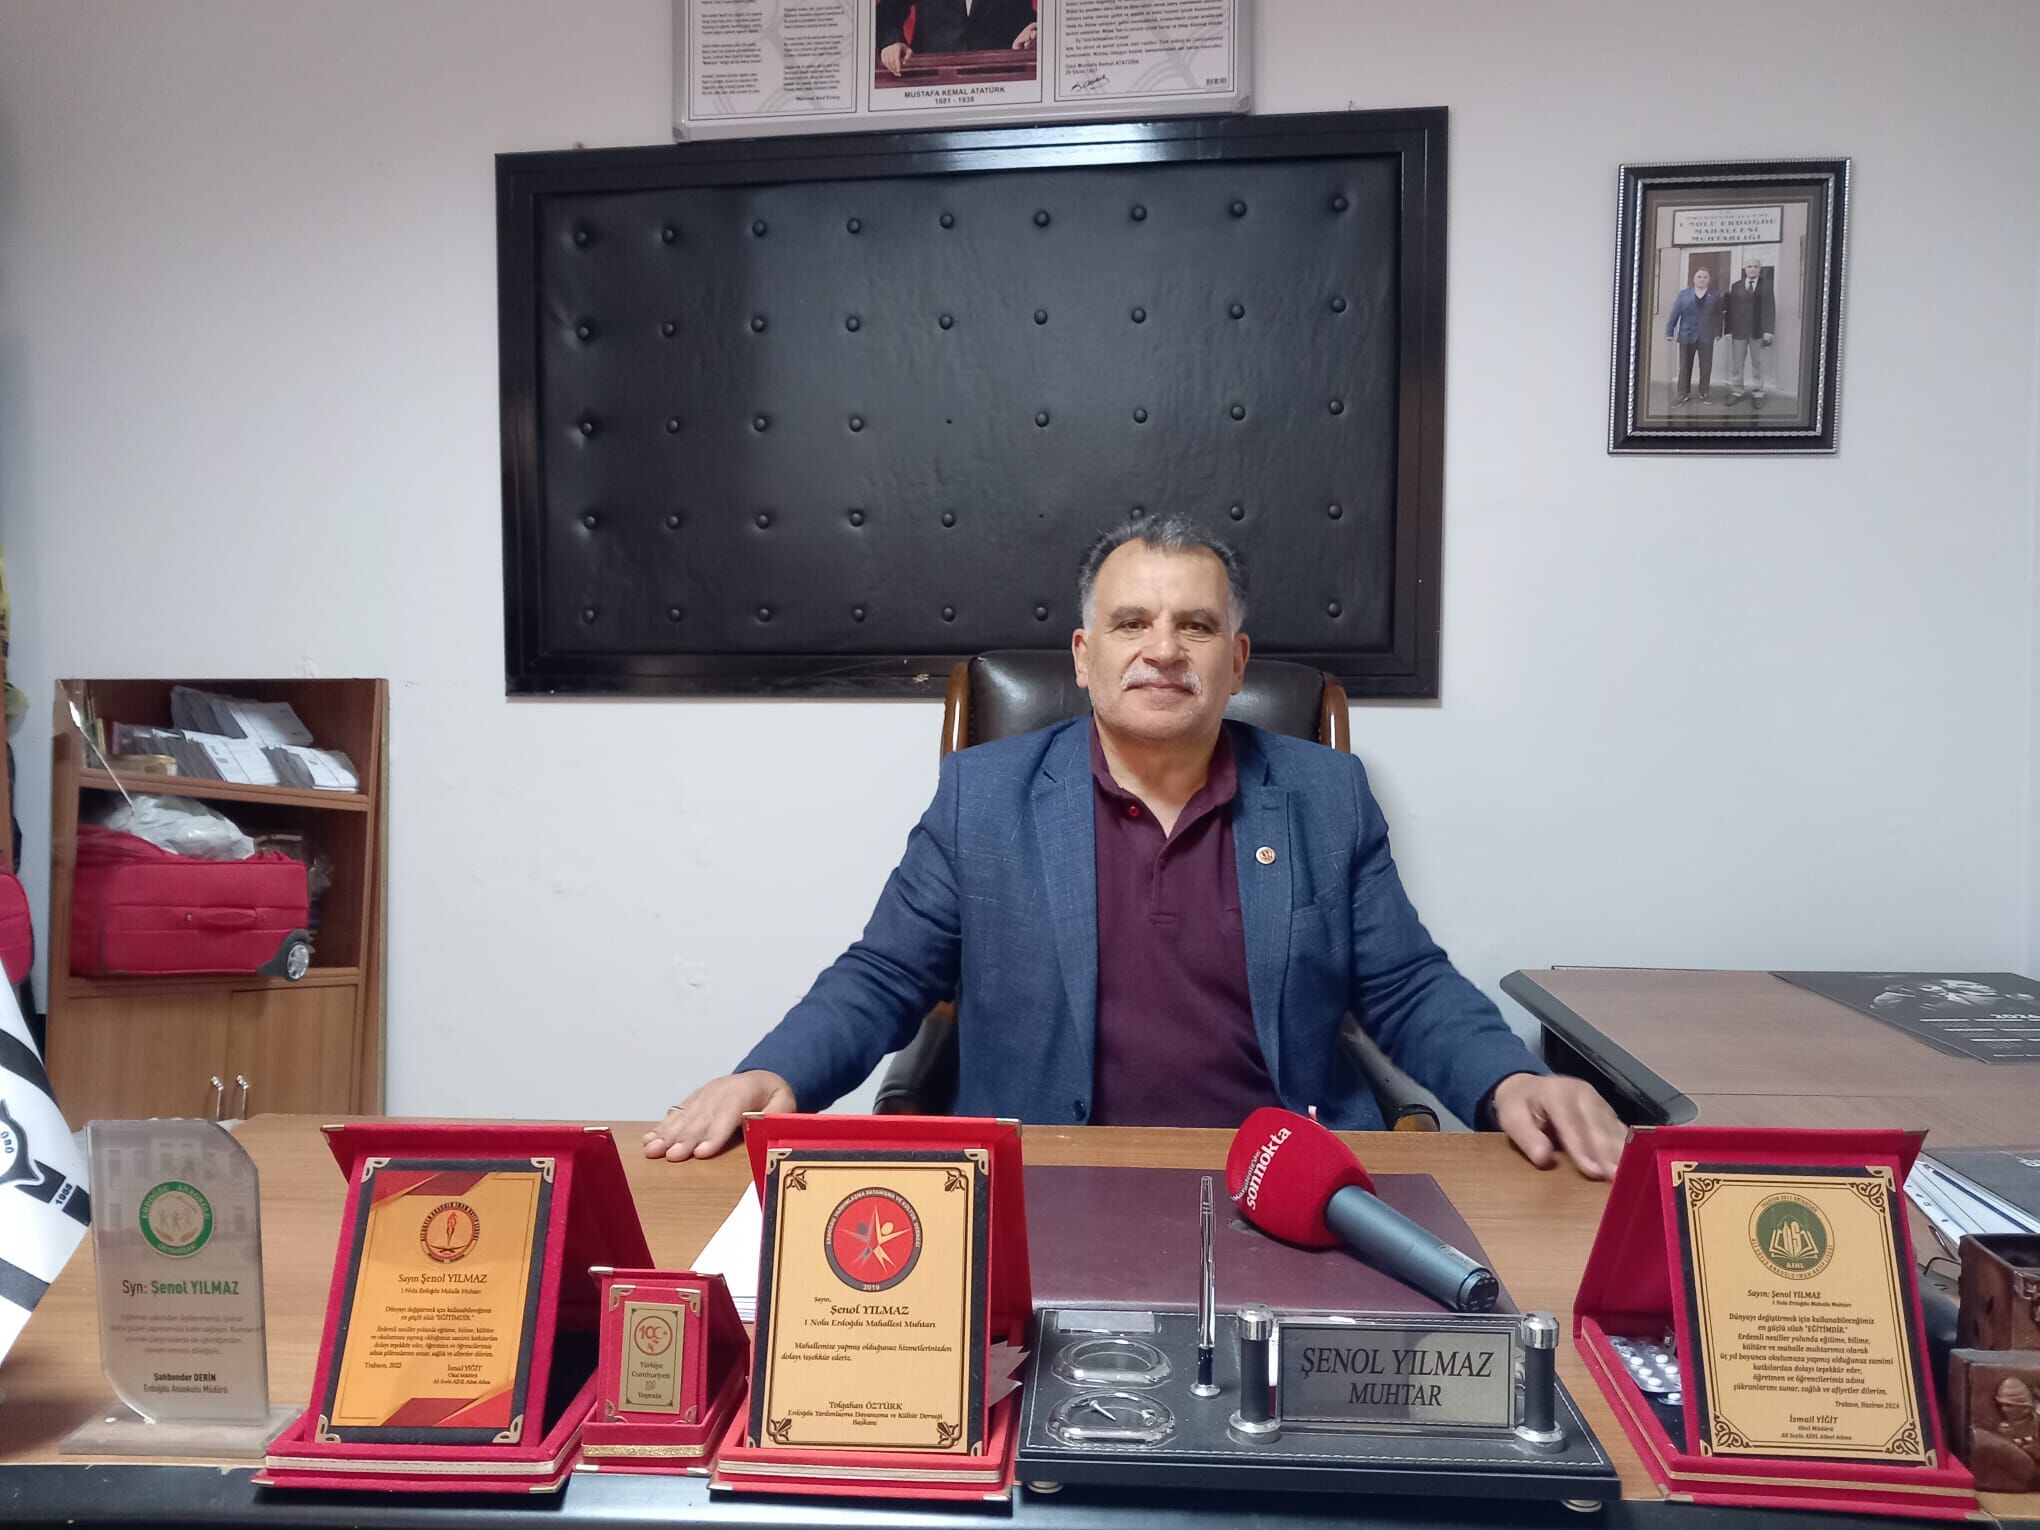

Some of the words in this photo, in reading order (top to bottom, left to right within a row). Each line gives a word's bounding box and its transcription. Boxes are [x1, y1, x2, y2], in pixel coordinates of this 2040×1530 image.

[904, 90, 940, 98] MUSTAFA
[970, 86, 1006, 94] ATATÜRK
[1246, 1127, 1293, 1211] sonnokta
[398, 1274, 419, 1284] Sayın
[420, 1273, 445, 1284] Şenol
[447, 1274, 488, 1284] YILMAZ
[122, 1280, 147, 1297] Syn:
[151, 1280, 188, 1297] Şenol
[190, 1280, 239, 1295] YILMAZ
[1747, 1289, 1770, 1299] Sayın:
[1771, 1290, 1791, 1299] Şenol
[1793, 1291, 1821, 1299] YILMAZ
[830, 1304, 860, 1316] Şenol
[862, 1305, 910, 1316] YILMAZ
[810, 1319, 830, 1327] Nolu
[831, 1319, 864, 1330] Erdoğdu
[865, 1320, 902, 1328] Mahallesi
[904, 1320, 936, 1328] Muhtarı
[1729, 1313, 1756, 1322] Dünyayı
[1757, 1314, 1797, 1323] değiştirmek
[1812, 1316, 1875, 1325] kullanabileceğimiz
[1737, 1333, 1764, 1341] Erdemli
[1765, 1334, 1790, 1342] nesiller
[794, 1342, 835, 1350] Mahallemize
[862, 1343, 897, 1353] olduğunuz
[898, 1343, 952, 1353] hizmetlerinizden
[781, 1352, 801, 1362] dolayı
[803, 1352, 830, 1362] teşekkür
[640, 1361, 664, 1369] Türkiye
[1301, 1347, 1385, 1379] ŞENOL
[1391, 1349, 1495, 1378] YILMAZ
[1348, 1383, 1443, 1406] MUHTAR
[829, 1401, 863, 1411] Tolgahan
[865, 1401, 903, 1410] ÖZTÜRK
[1789, 1414, 1814, 1424] İsmail
[1816, 1415, 1838, 1424] YİĞİT
